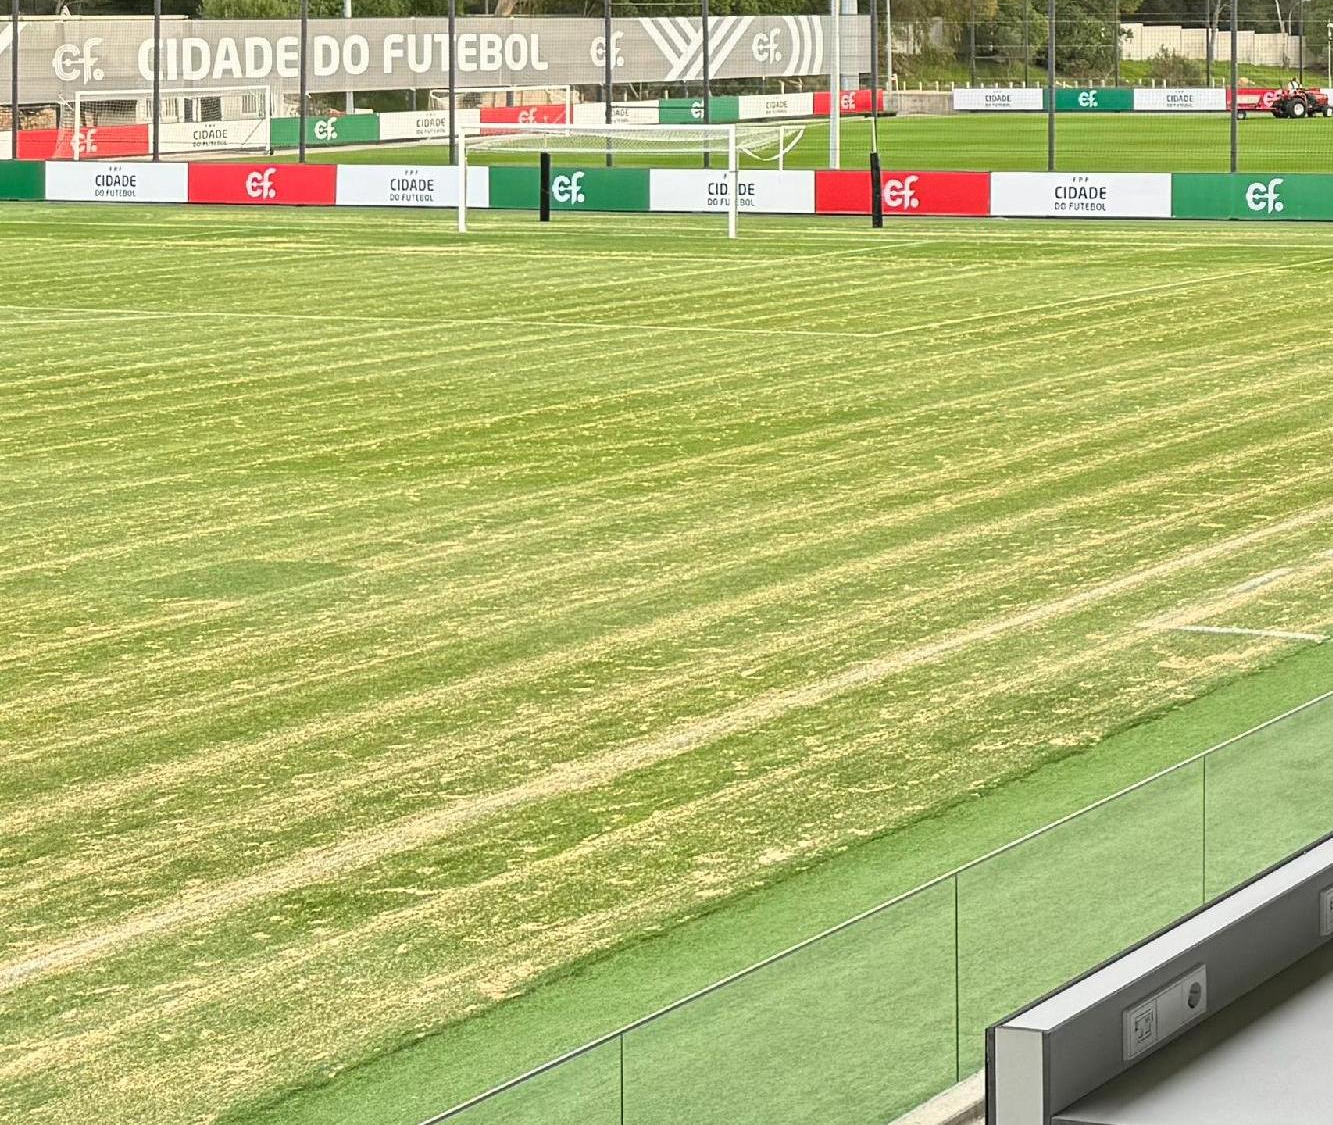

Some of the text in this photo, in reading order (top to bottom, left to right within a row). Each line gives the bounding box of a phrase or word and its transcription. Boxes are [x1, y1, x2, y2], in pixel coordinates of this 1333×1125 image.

[138, 36, 299, 81] CIDADE
[313, 34, 370, 76] DO
[383, 33, 549, 74] FUTEBOL
[95, 175, 137, 187] CIDADE
[390, 178, 434, 192] CIDADE
[708, 183, 755, 196] CIDDE
[1055, 186, 1107, 200] CIDADE
